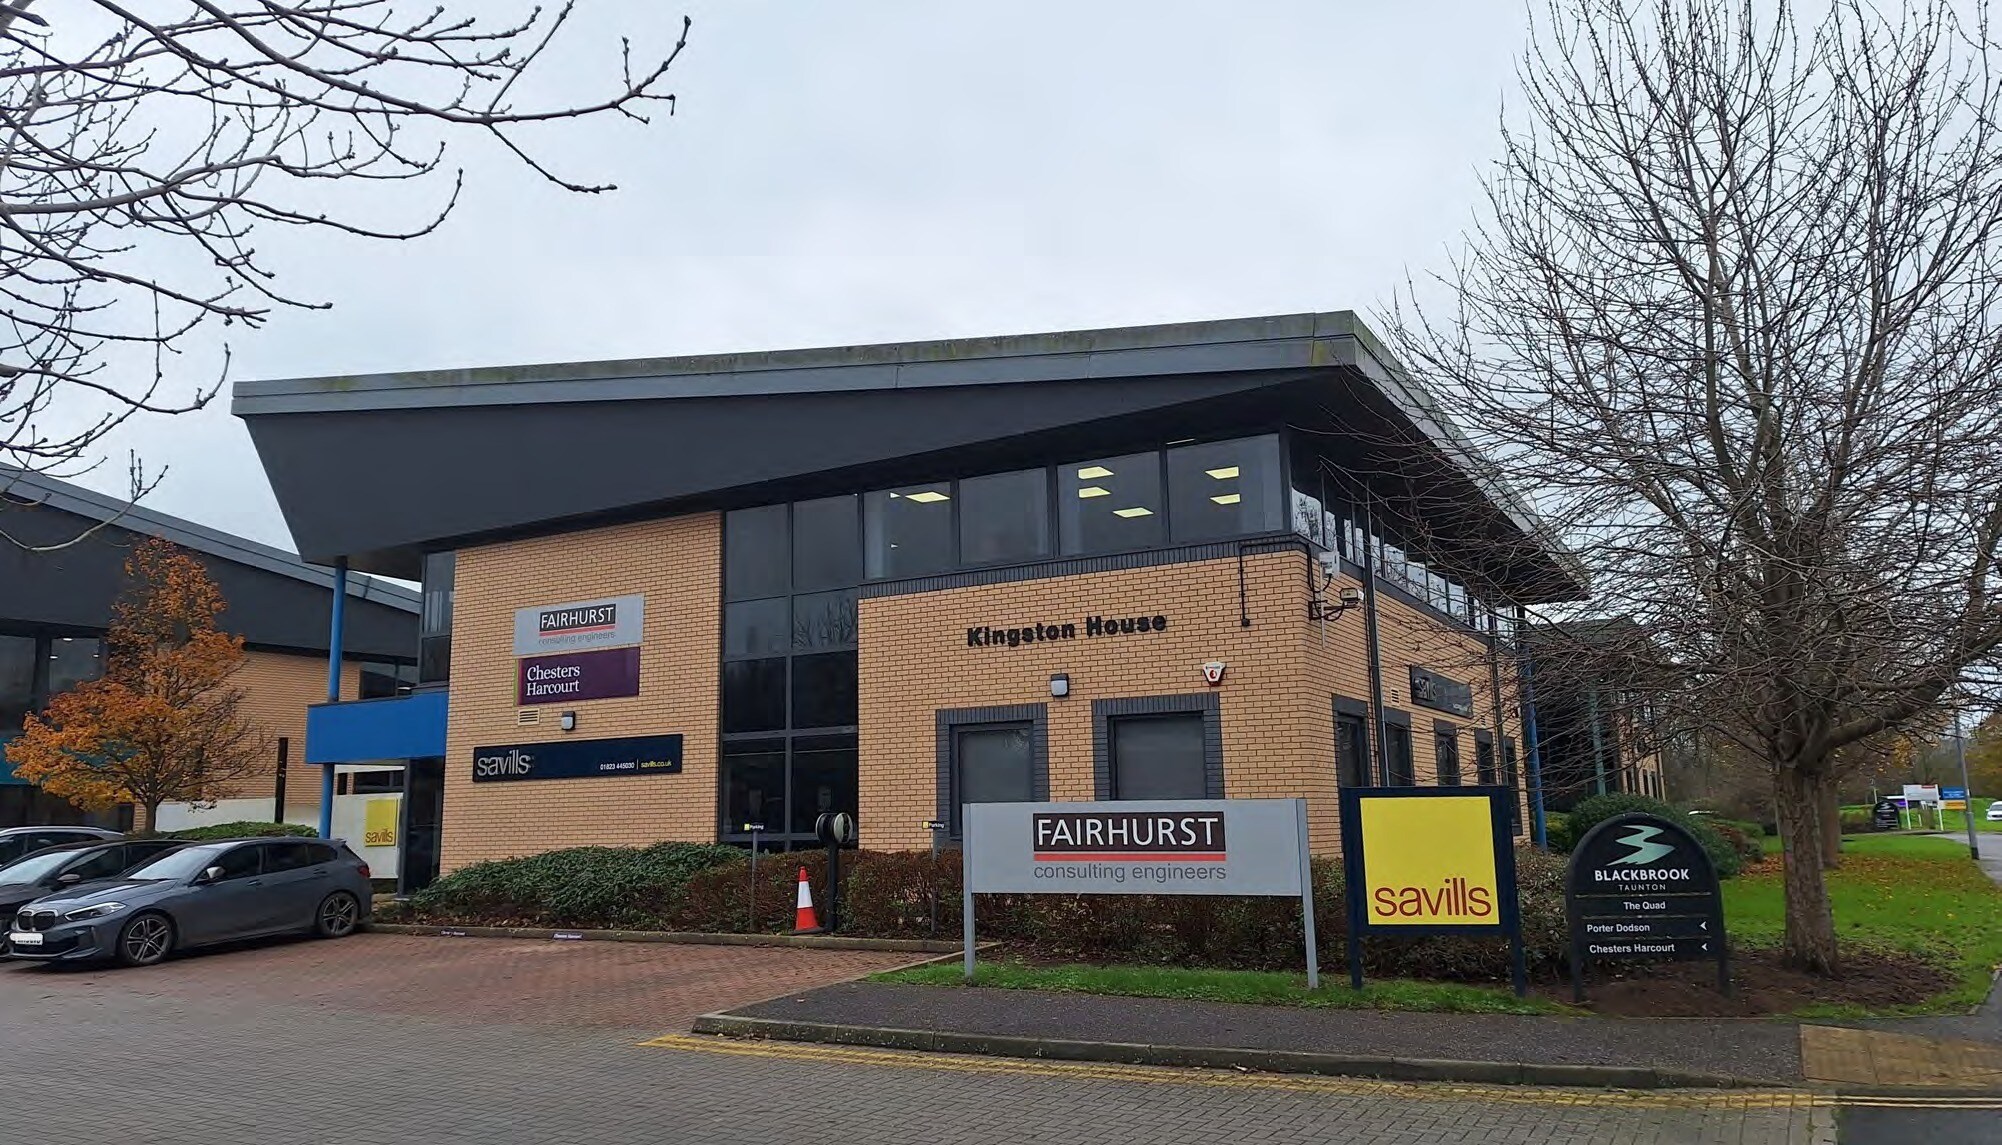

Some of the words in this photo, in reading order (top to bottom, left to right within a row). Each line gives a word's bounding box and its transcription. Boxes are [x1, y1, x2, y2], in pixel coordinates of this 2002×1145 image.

[541, 607, 614, 629] FAIRHURST
[538, 633, 576, 646] consulting
[578, 631, 617, 643] engineers
[967, 622, 1075, 647] Kingston
[1086, 615, 1167, 637] House
[526, 665, 581, 681] Chesters
[526, 680, 580, 696] Harcourt
[477, 749, 532, 776] savills
[599, 763, 616, 771] 01823
[641, 760, 672, 768] savills.co.uk
[365, 829, 394, 843] savills
[1038, 817, 1219, 847] FAIRHURST
[1033, 863, 1126, 883] consulting
[1132, 863, 1227, 883] engineers
[1594, 868, 1690, 882] BLACKBROOK
[1374, 877, 1492, 917] savills
[1623, 901, 1641, 910] The
[1642, 901, 1666, 910] Quad
[1586, 924, 1614, 932] Porter
[1616, 923, 1650, 932] Dodson
[1589, 944, 1632, 954] Chesters
[1634, 943, 1675, 952] Harcourt
